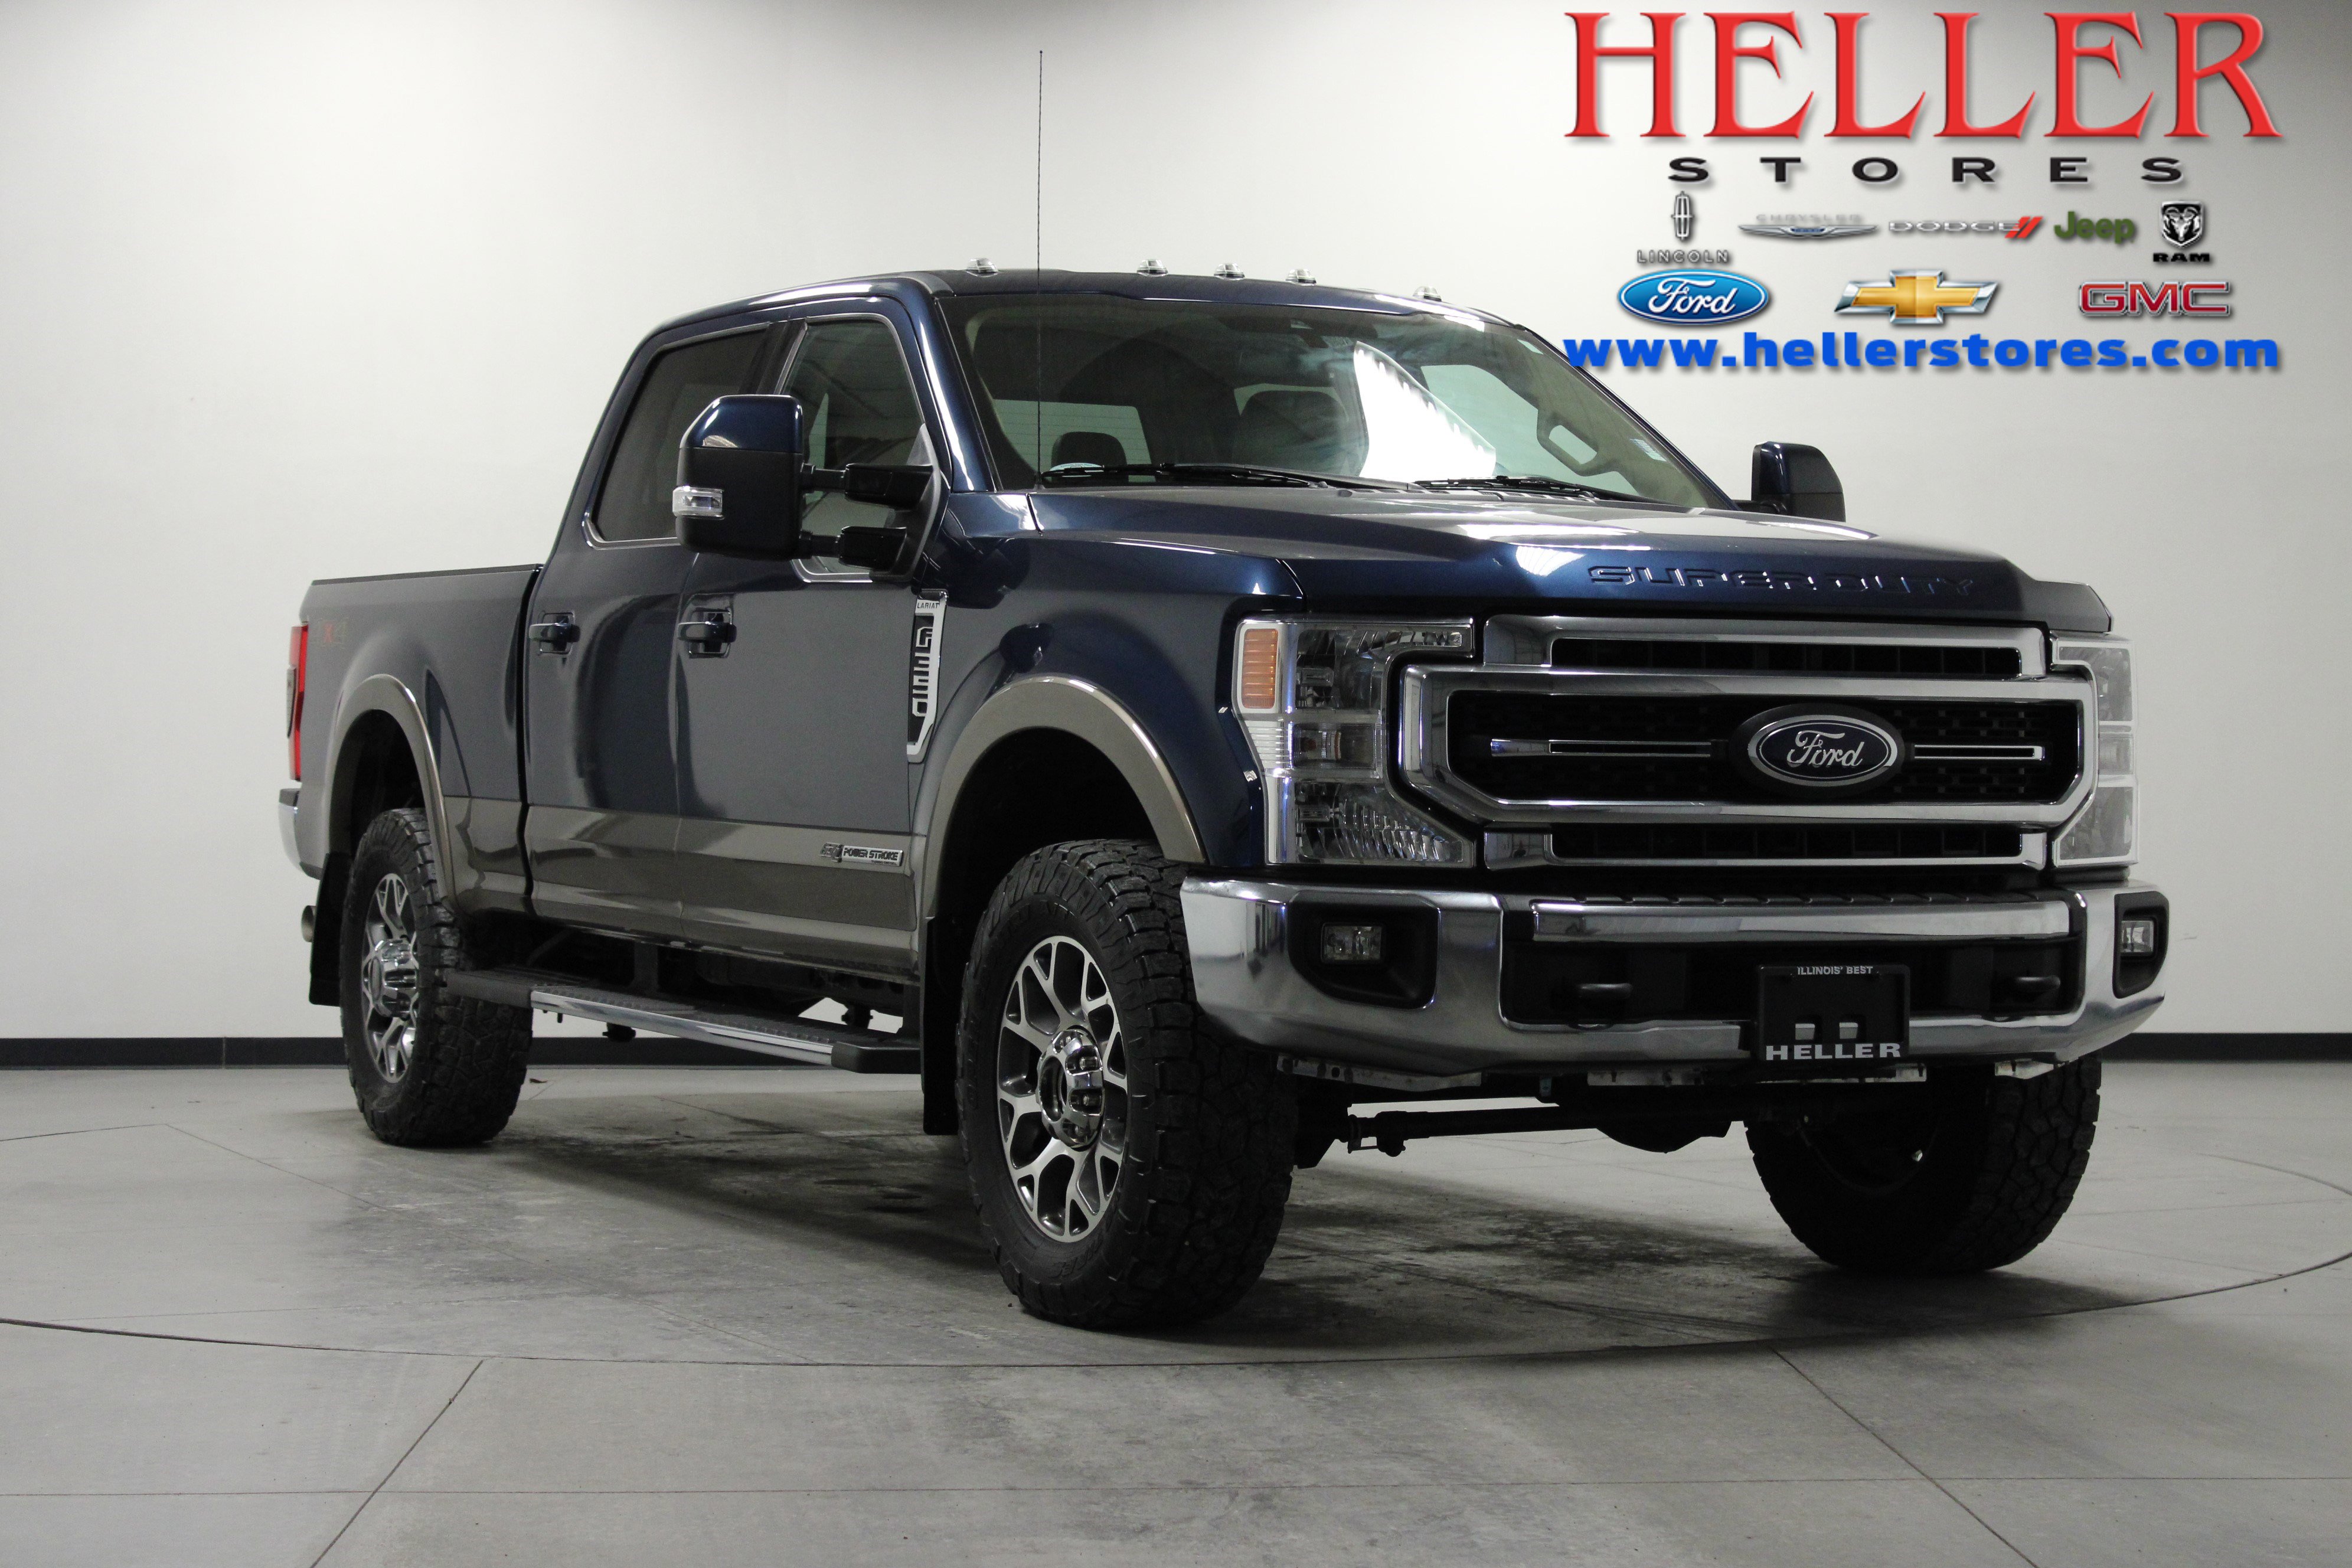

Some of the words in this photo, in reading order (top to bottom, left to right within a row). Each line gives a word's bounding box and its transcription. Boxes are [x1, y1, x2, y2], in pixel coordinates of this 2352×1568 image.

[1587, 565, 1817, 590] SUPER
[1786, 730, 1866, 767] Ford
[843, 847, 868, 858] POWER
[868, 850, 899, 861] STROKE
[1845, 965, 1873, 974] BEST
[1766, 1043, 1901, 1061] HELLER
